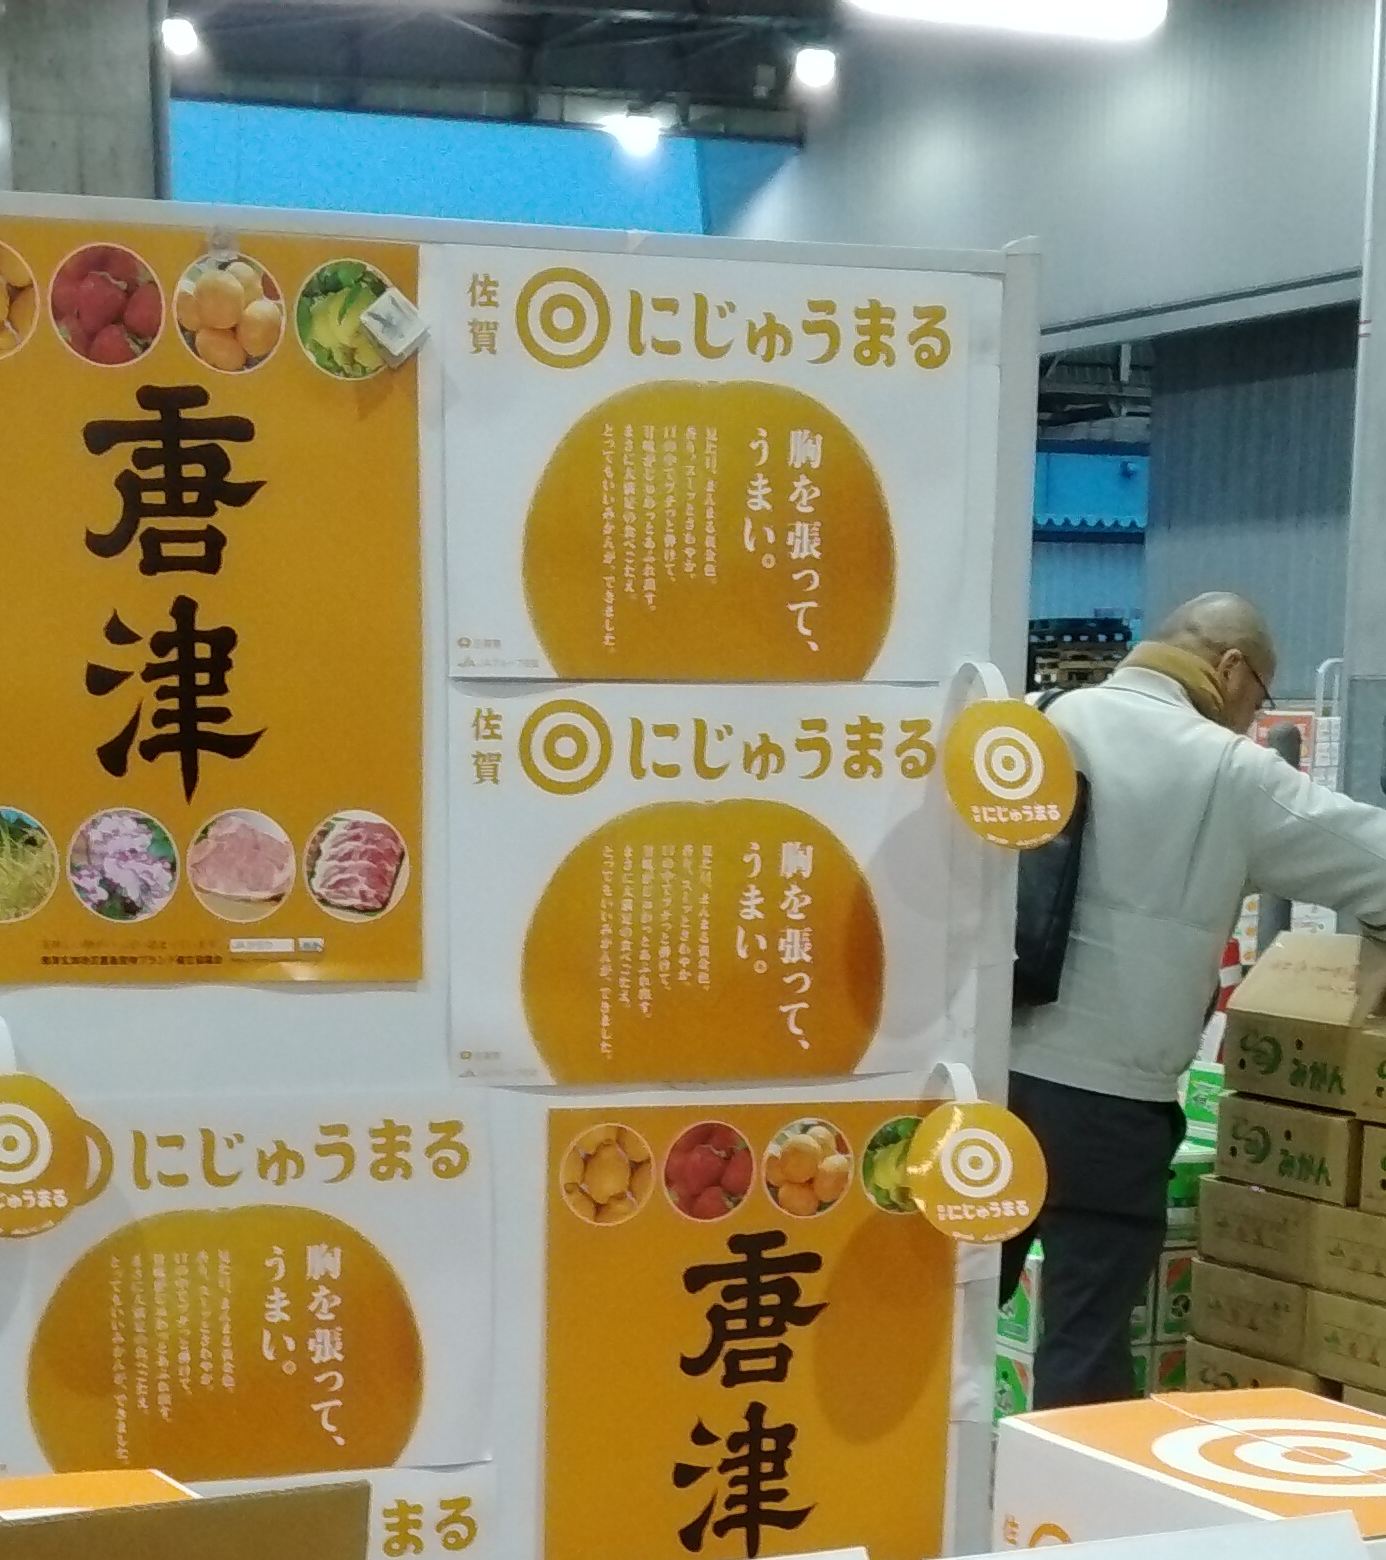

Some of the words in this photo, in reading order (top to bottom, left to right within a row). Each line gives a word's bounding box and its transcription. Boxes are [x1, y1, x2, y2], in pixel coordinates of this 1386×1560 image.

[466, 273, 501, 356] 佐賀
[627, 288, 953, 370] にじゅうまる
[743, 427, 776, 570] うまい。
[786, 428, 824, 653] 胸を張って、
[83, 383, 268, 803] 唐津
[470, 706, 503, 786] 佐賀
[629, 714, 937, 782] にじゅうまる
[982, 804, 1061, 822] にじゅうまる
[735, 841, 770, 974] うまい。
[776, 840, 814, 1050] 胸を張って、
[1290, 1055, 1345, 1096] みかん
[132, 1117, 471, 1191] にじゅうまる
[1279, 1147, 1331, 1187] みかん
[946, 1199, 1030, 1221] にじゅうまる
[263, 1245, 297, 1375] うまい。
[305, 1242, 346, 1447] 胸を張って、
[674, 1230, 829, 1558] 唐津
[382, 1496, 479, 1558] まる
